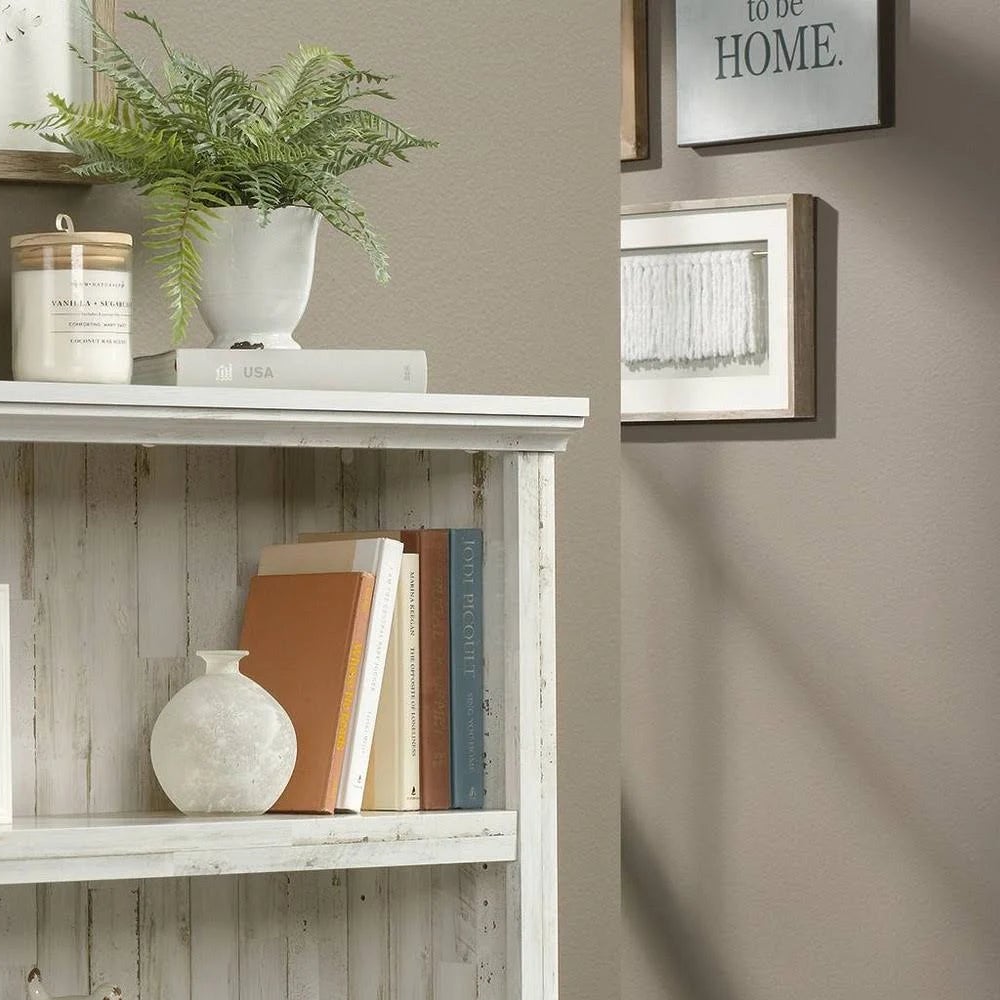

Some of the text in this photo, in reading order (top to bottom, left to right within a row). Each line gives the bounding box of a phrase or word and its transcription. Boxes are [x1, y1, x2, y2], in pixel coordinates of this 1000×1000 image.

[747, 0, 804, 22] to be
[714, 22, 843, 80] HOME.
[244, 366, 274, 379] USA
[462, 593, 476, 679] PICOULT
